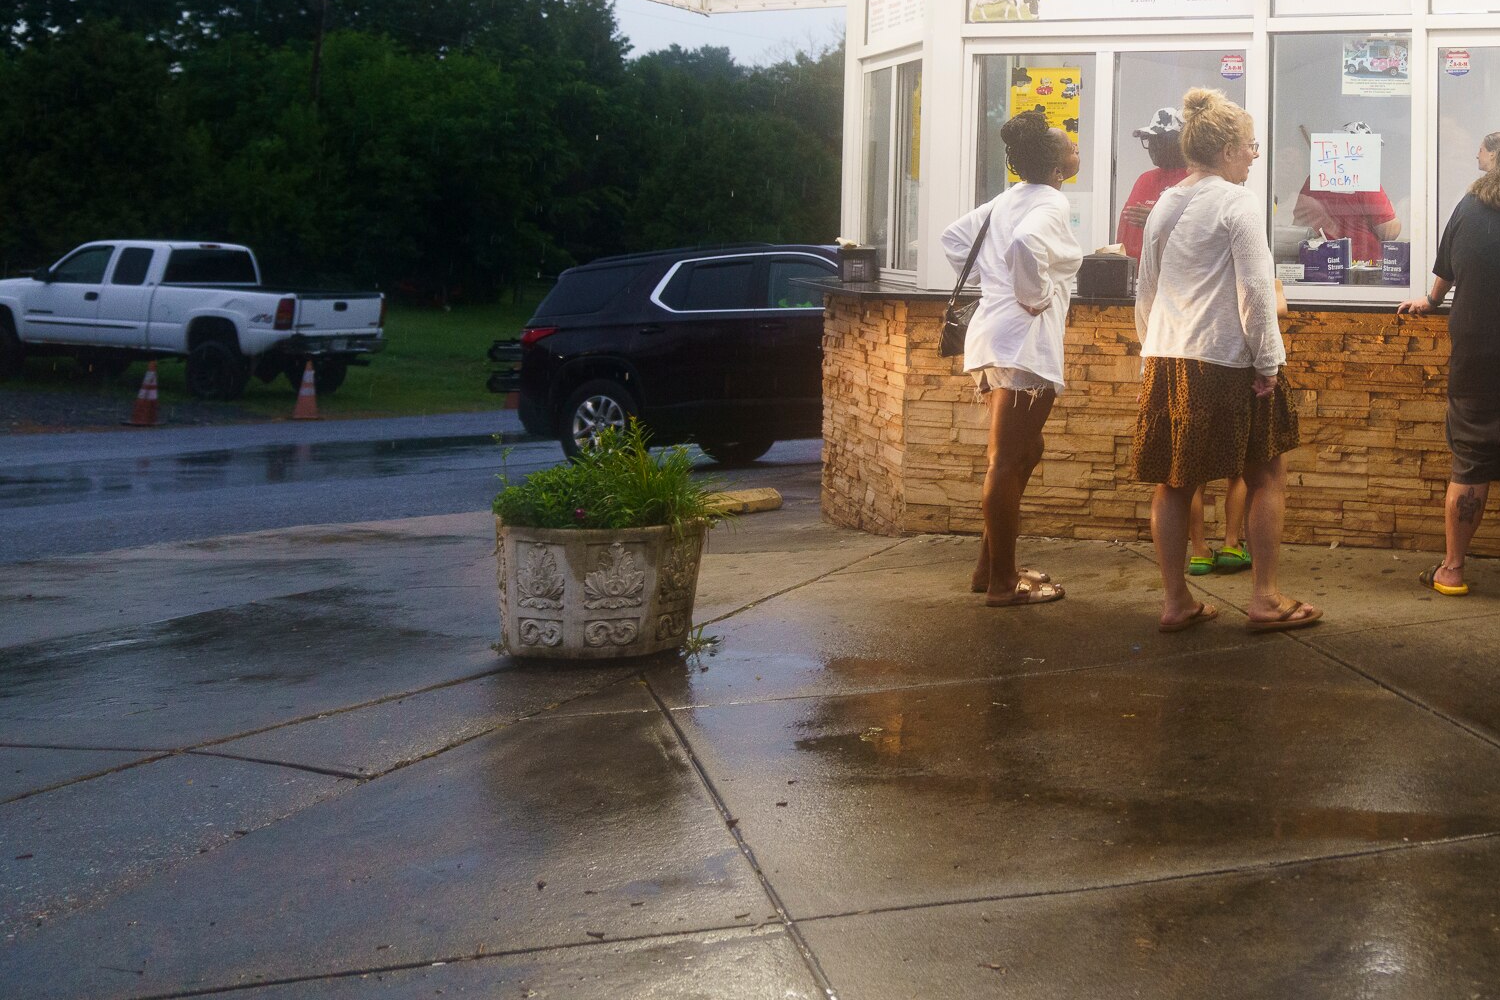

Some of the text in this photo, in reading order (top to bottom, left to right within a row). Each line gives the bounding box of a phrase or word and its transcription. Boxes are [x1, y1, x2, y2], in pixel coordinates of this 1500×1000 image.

[1314, 141, 1363, 161] Tri Ice
[1334, 159, 1345, 175] Is
[1318, 172, 1360, 188] Back!!
